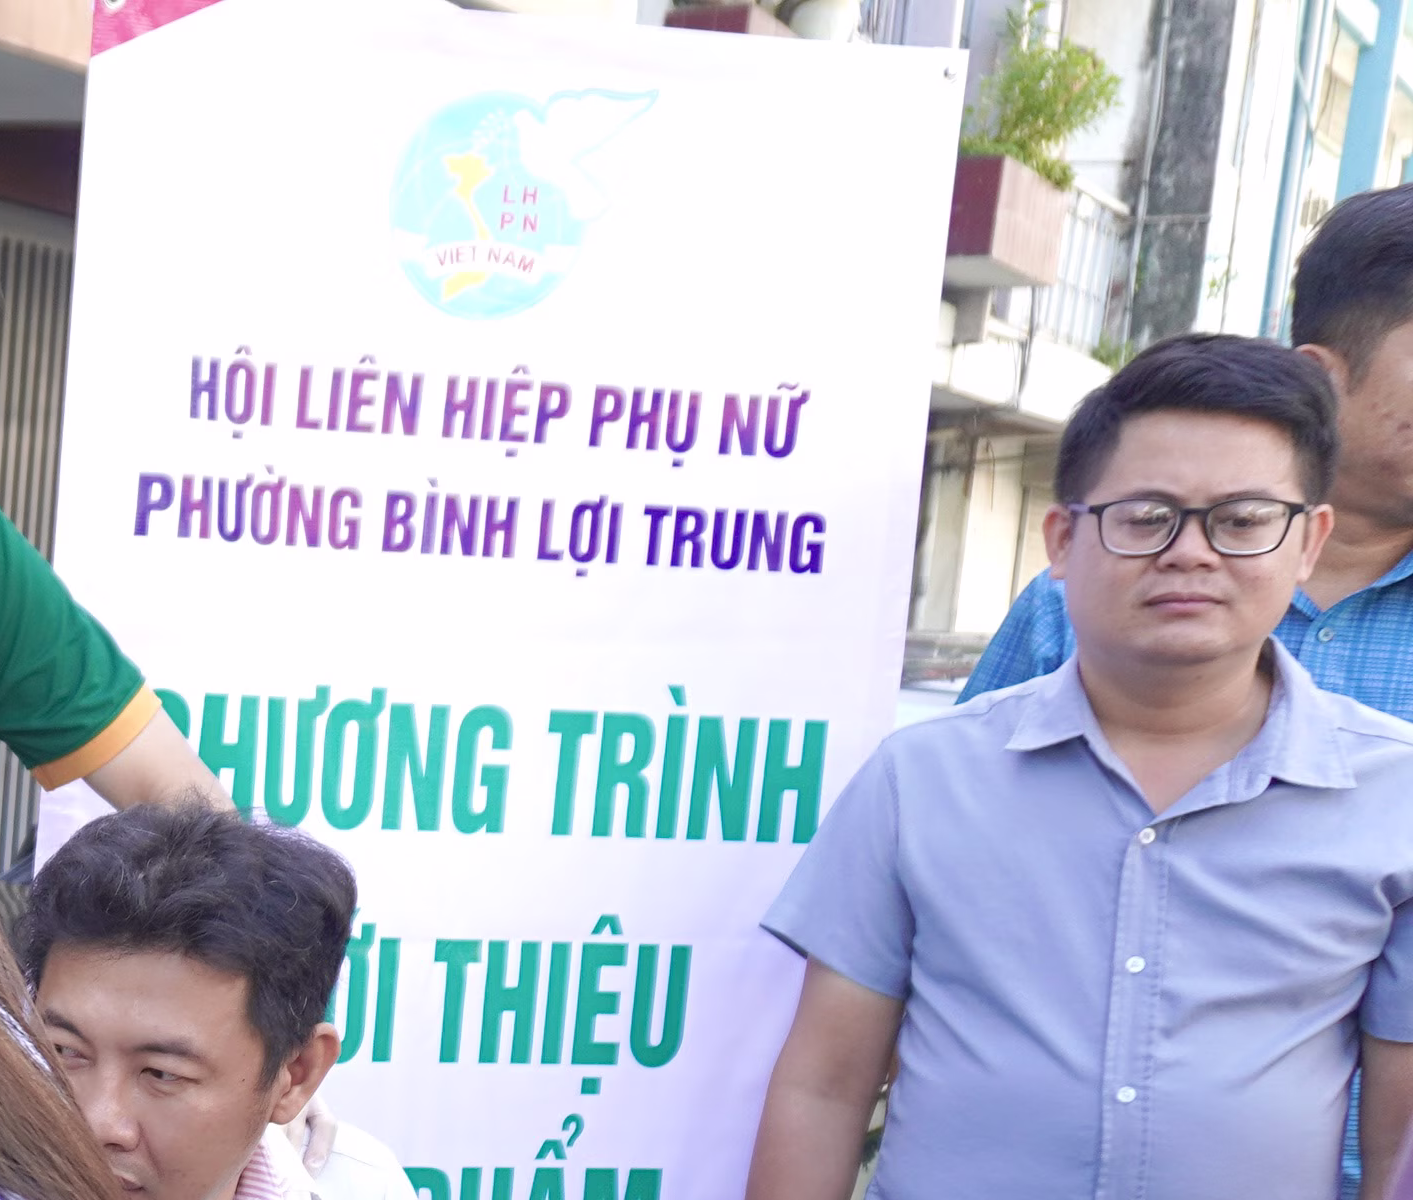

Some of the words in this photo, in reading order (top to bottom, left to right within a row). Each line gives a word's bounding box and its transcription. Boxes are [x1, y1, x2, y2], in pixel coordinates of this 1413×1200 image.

[488, 247, 535, 273] NAM
[189, 346, 275, 439] HỘI
[295, 355, 424, 436] LIÊN
[441, 366, 572, 457] HIỆP
[588, 387, 699, 467] PHỤ
[718, 383, 810, 459] NỮ
[134, 465, 363, 551] PHƯỜNG
[381, 478, 519, 560] BÌNH
[536, 496, 625, 578] LỢI
[644, 505, 828, 576] TRUNG
[153, 684, 515, 834] HƯƠNG
[548, 684, 829, 844] TRÌNH
[435, 915, 693, 1095] THIỆU
